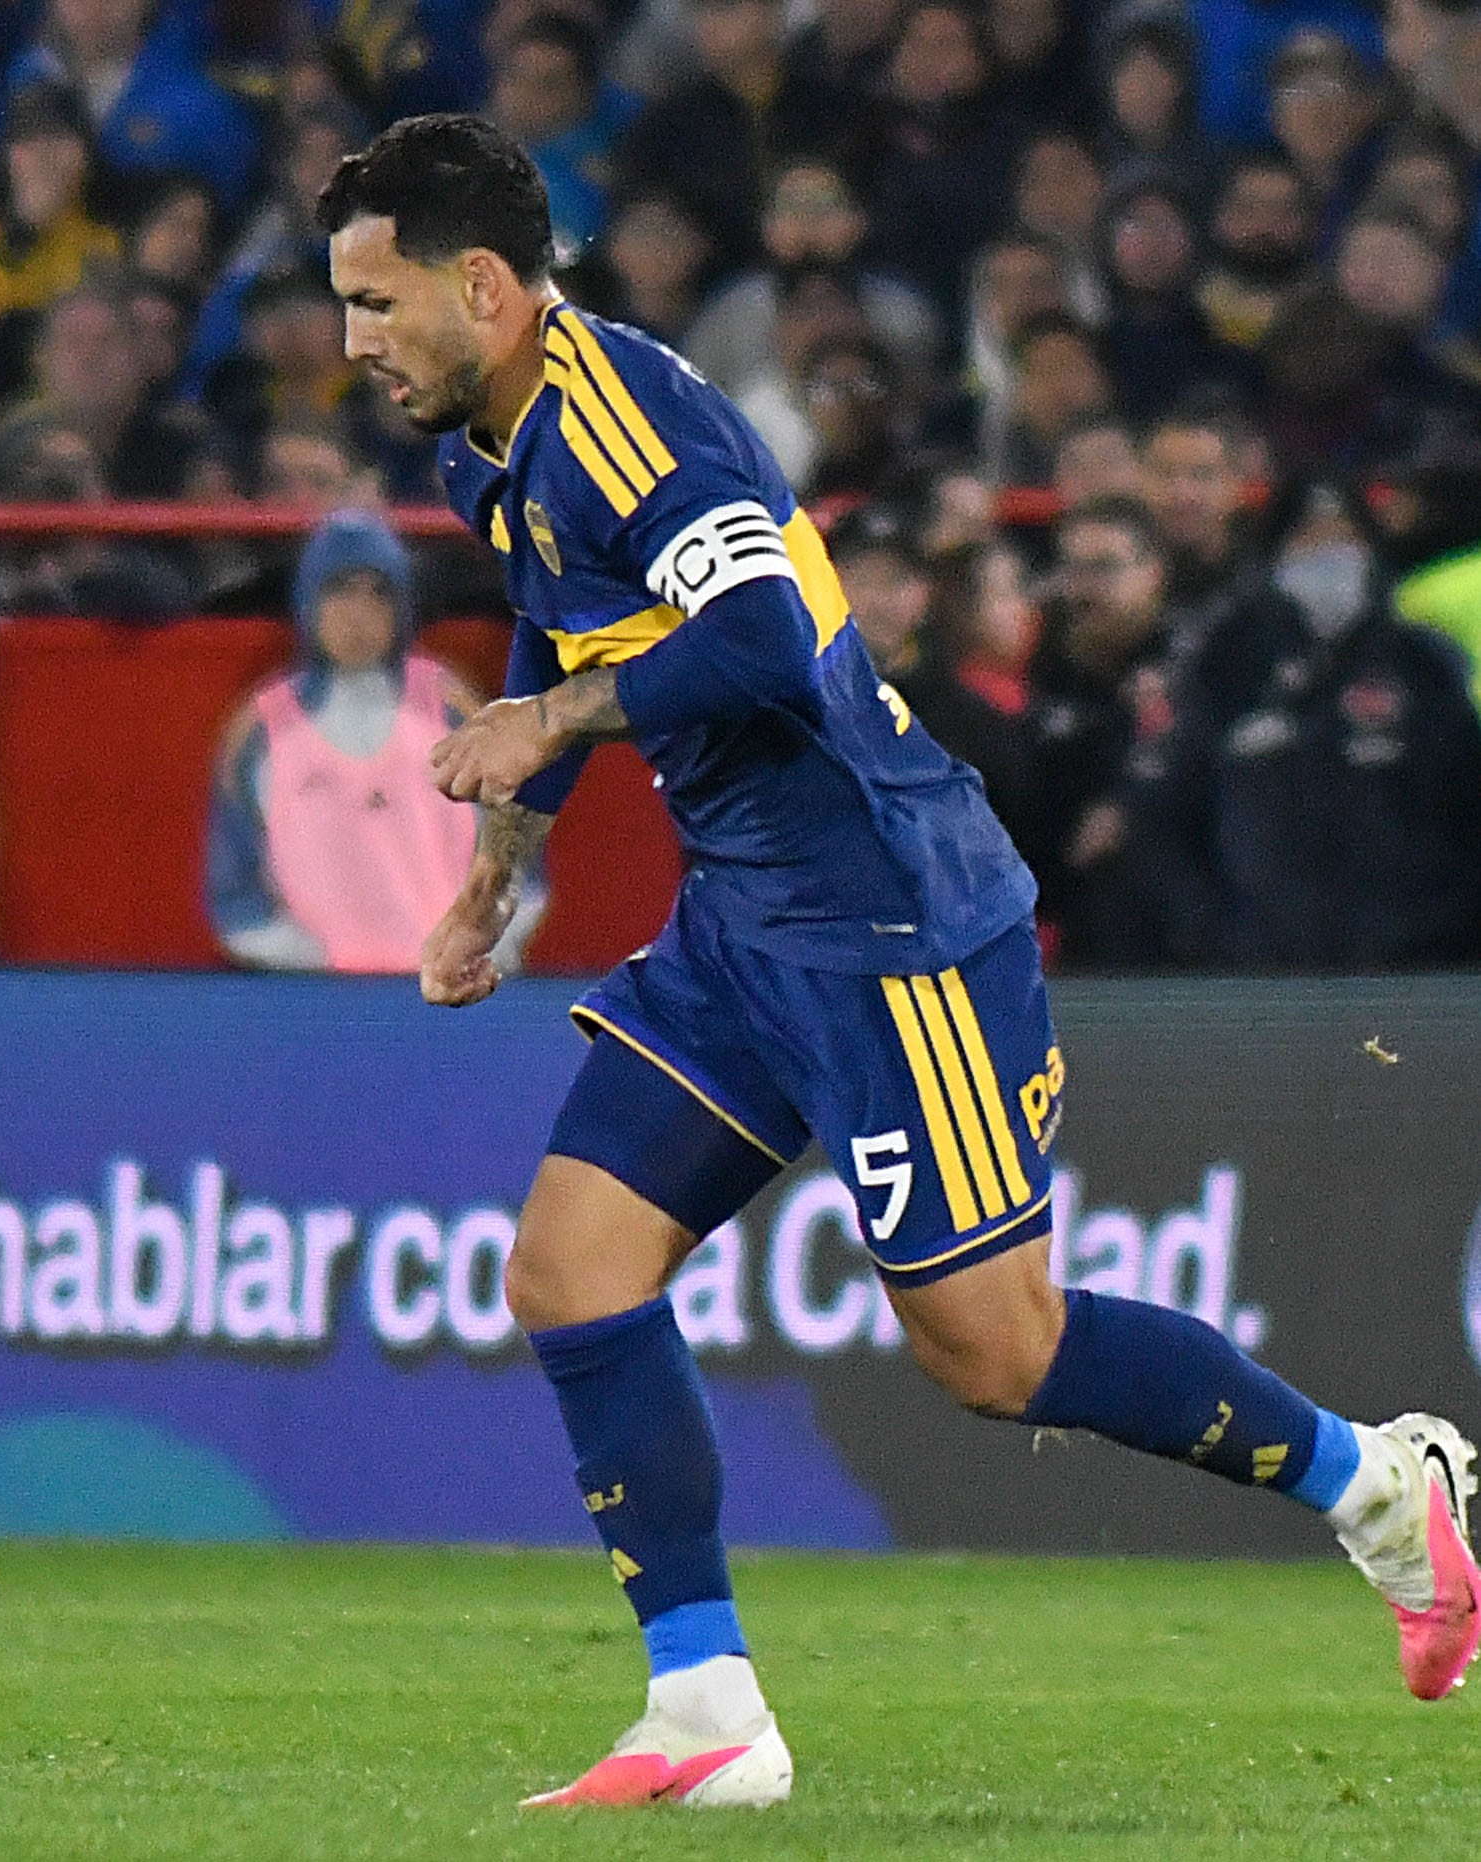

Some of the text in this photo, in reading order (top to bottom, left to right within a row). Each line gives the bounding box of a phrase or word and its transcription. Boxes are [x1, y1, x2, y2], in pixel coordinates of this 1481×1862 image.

[851, 1130, 912, 1240] 5
[368, 1207, 518, 1346] co
[771, 1170, 1264, 1348] Cad.
